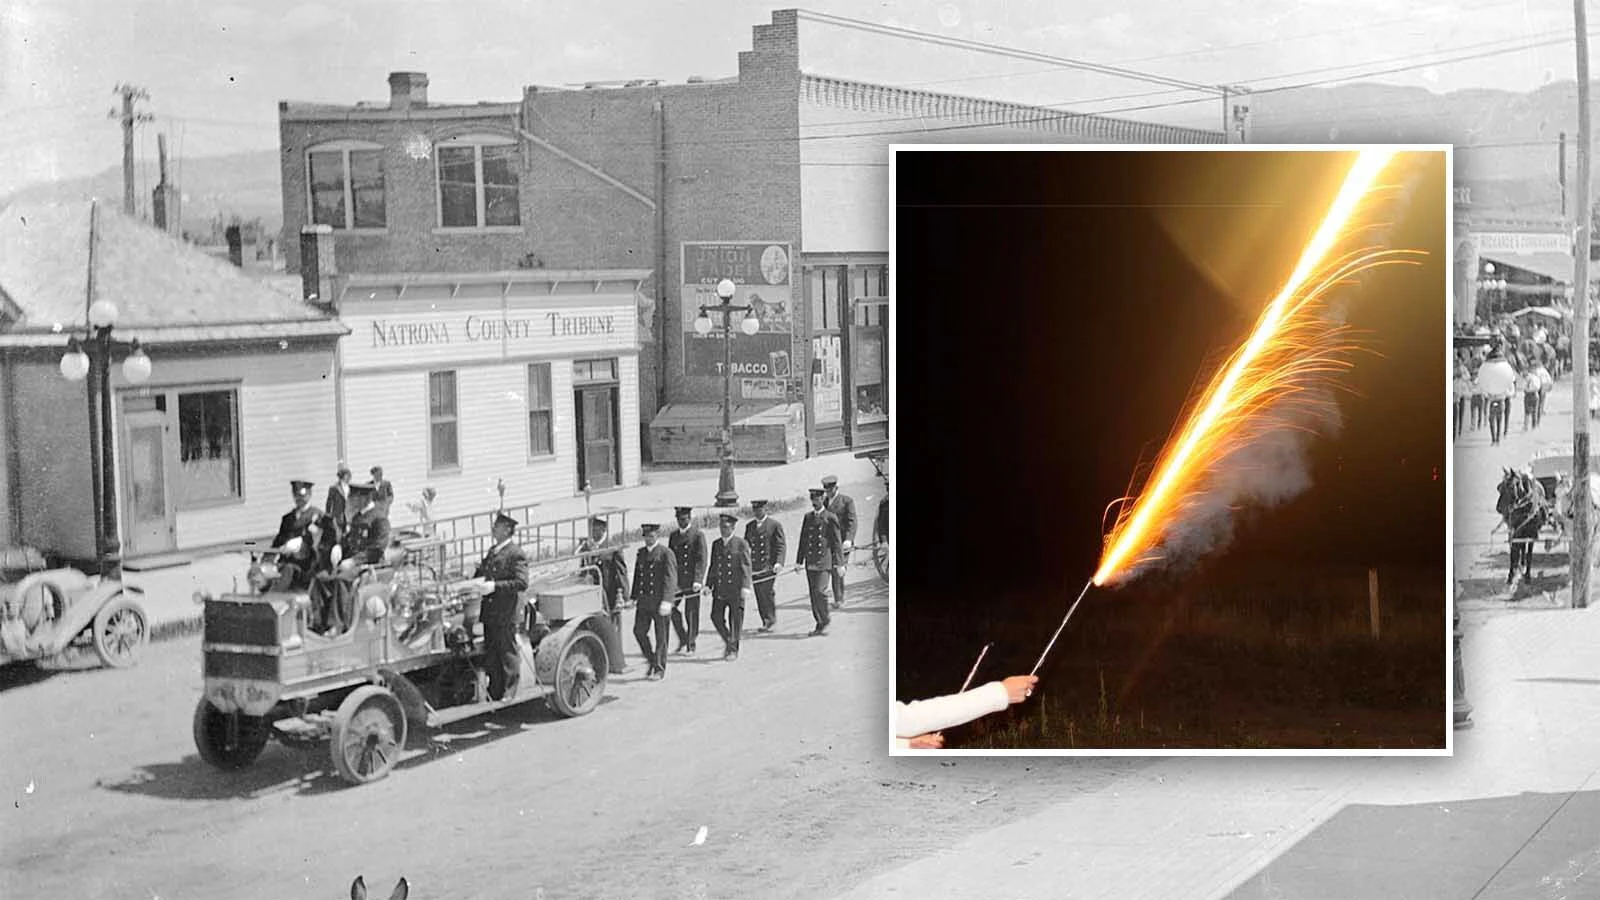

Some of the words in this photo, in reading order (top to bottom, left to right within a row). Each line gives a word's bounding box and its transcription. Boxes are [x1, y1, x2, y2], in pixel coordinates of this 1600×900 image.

[371, 319, 451, 348] NATRONA
[465, 315, 530, 342] COUNTY
[544, 311, 616, 337] TRIBUNE
[716, 362, 768, 375] TBACCO
